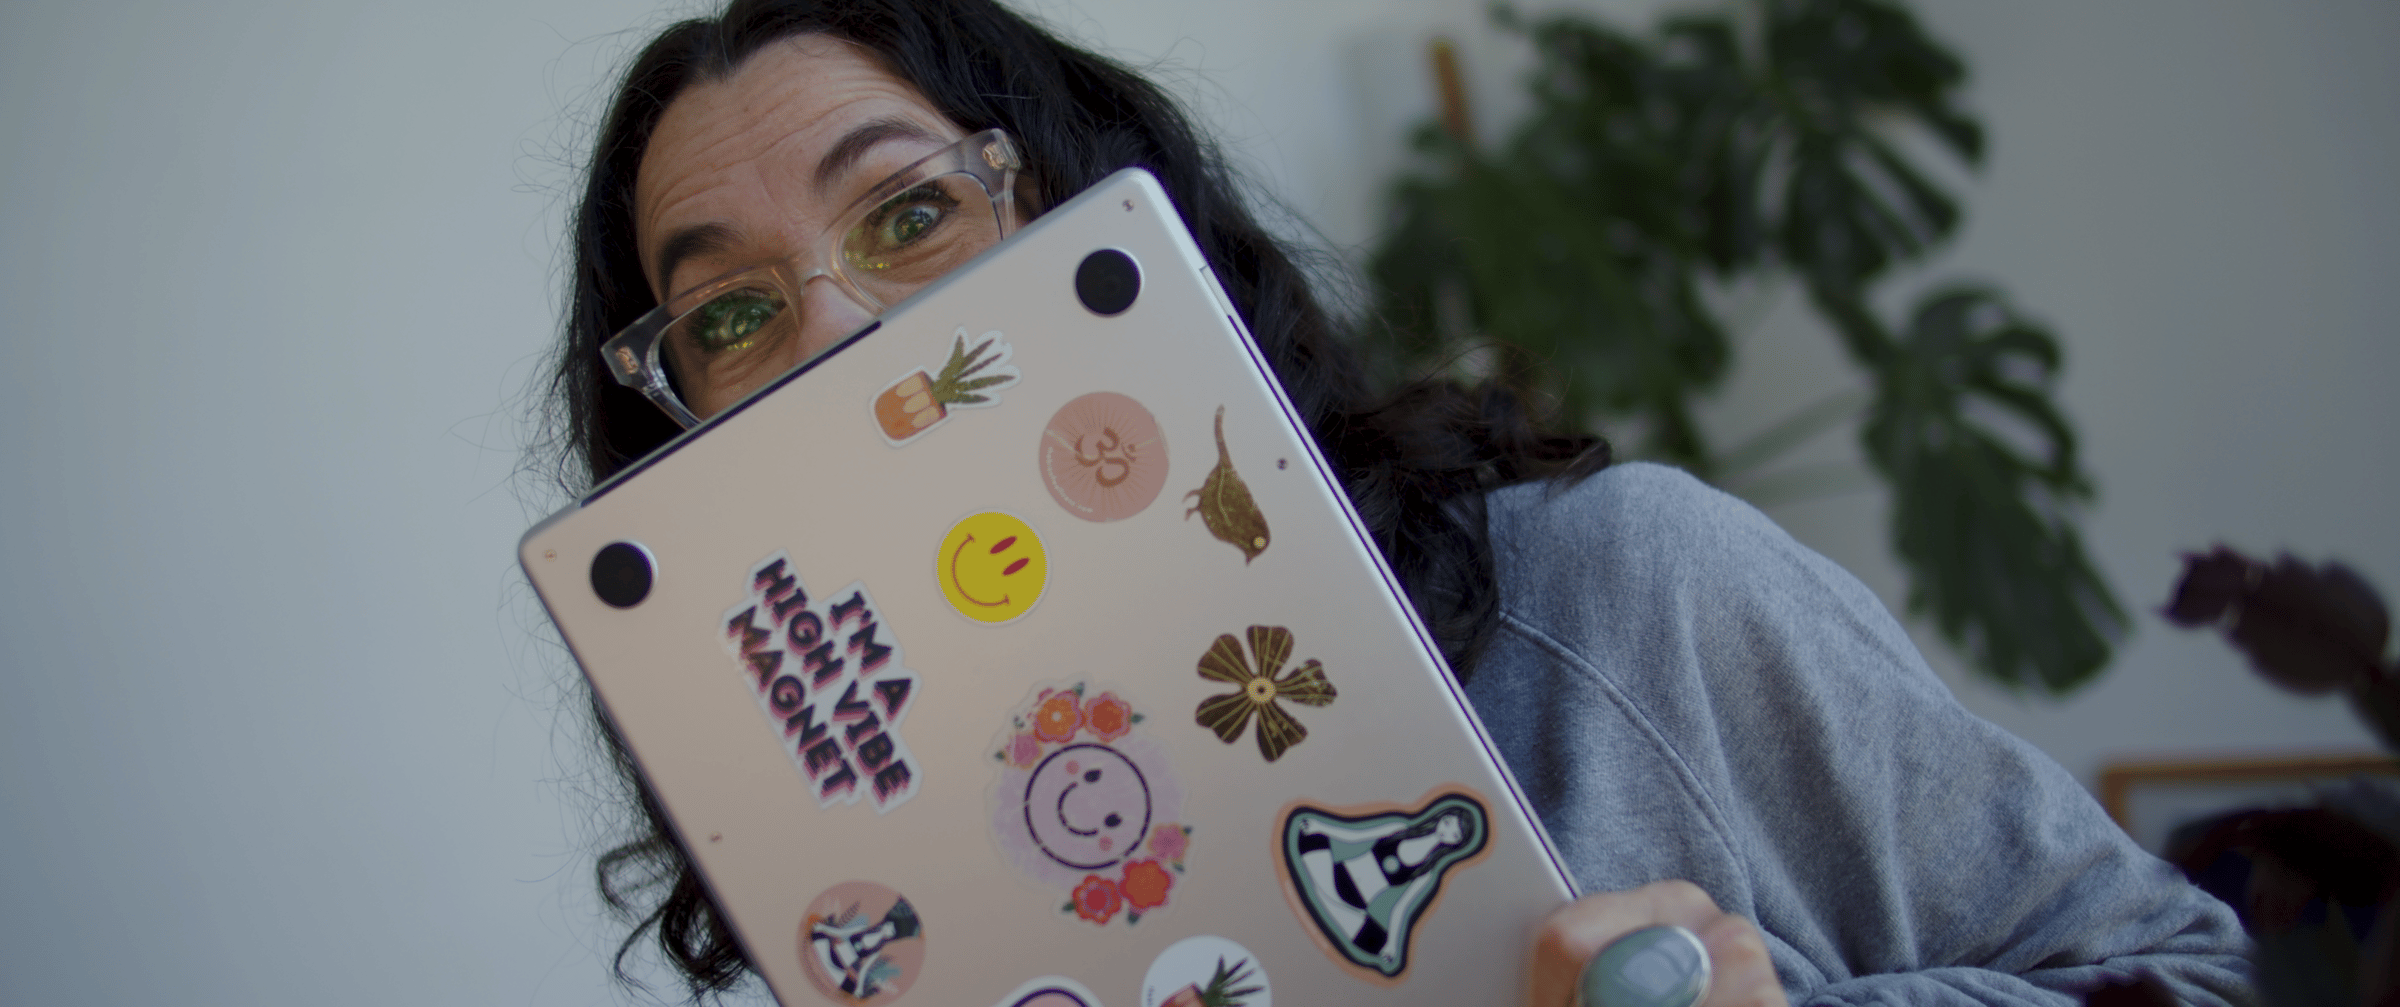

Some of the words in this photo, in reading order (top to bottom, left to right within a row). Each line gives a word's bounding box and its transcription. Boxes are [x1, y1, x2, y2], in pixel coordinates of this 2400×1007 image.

[727, 605, 858, 798] MAGNET
[754, 558, 845, 692] HIGH
[832, 679, 912, 803] VIBE
[829, 590, 892, 676] I'M
[874, 678, 912, 723] A
